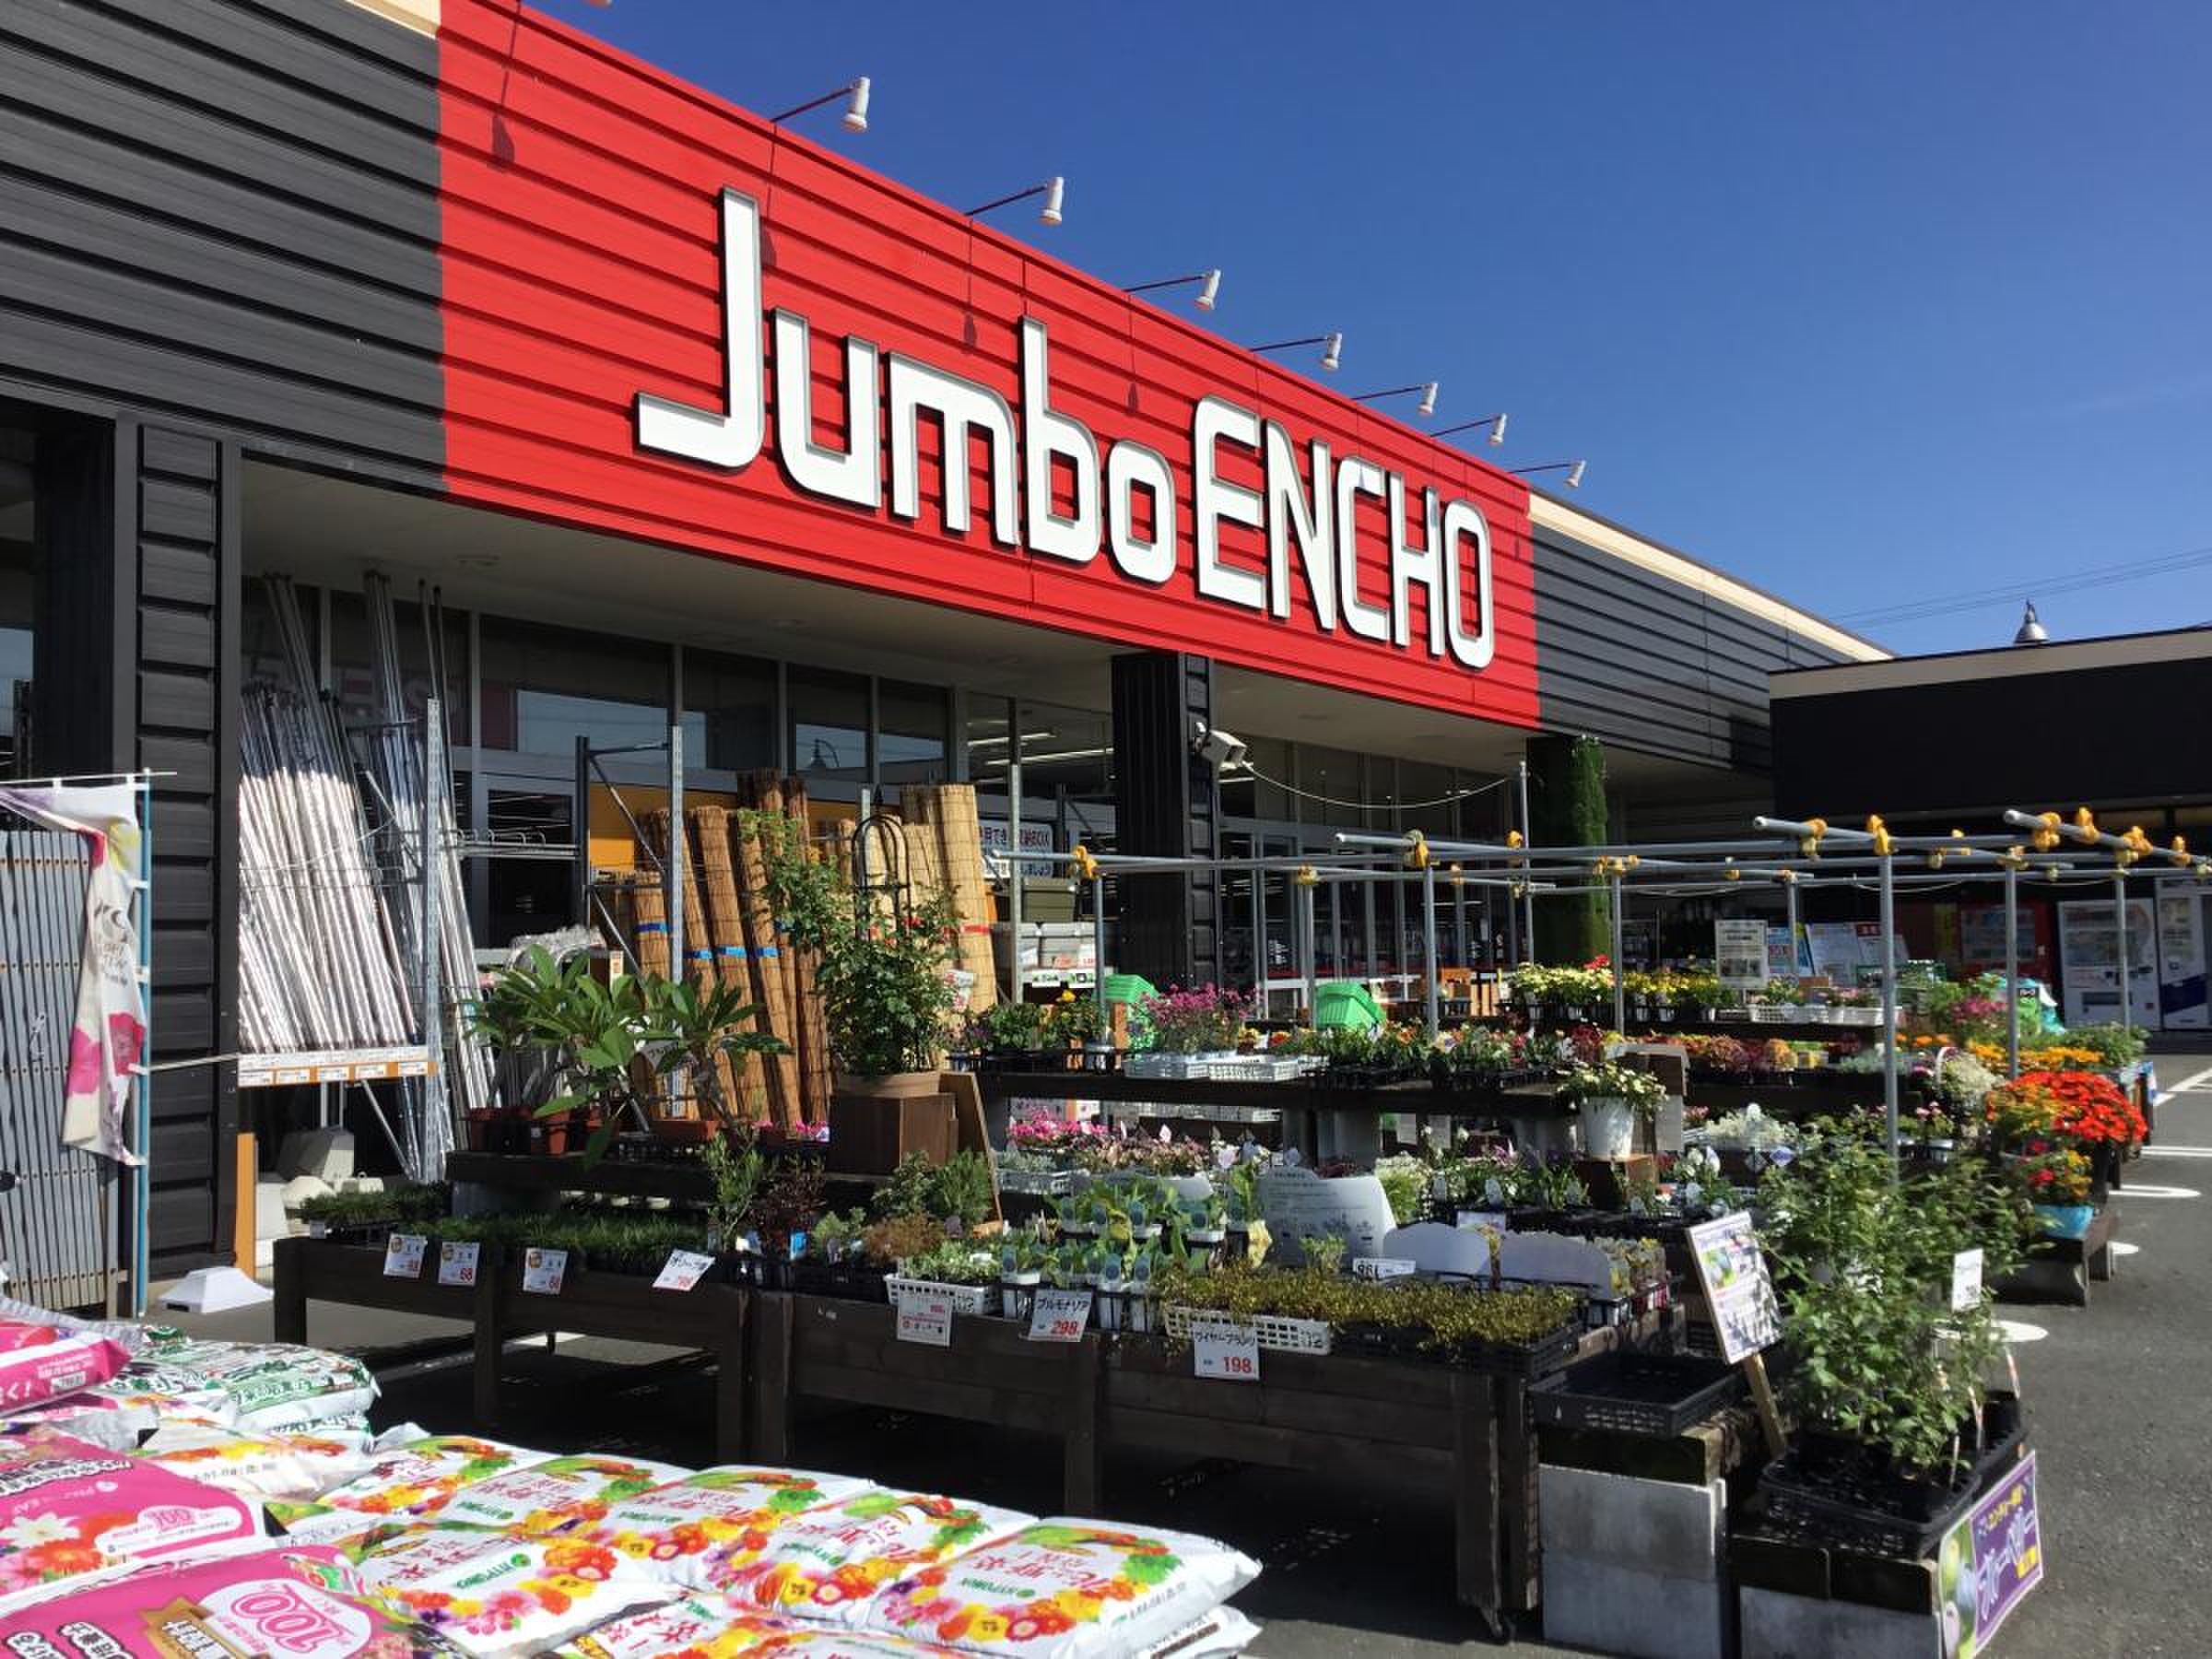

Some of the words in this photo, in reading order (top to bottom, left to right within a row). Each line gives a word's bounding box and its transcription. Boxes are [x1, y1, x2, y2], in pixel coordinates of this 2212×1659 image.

[635, 187, 1176, 582] Jumbo
[1195, 394, 1494, 668] ENCHO
[1051, 1320, 1078, 1335] 298
[1224, 1356, 1253, 1373] 198
